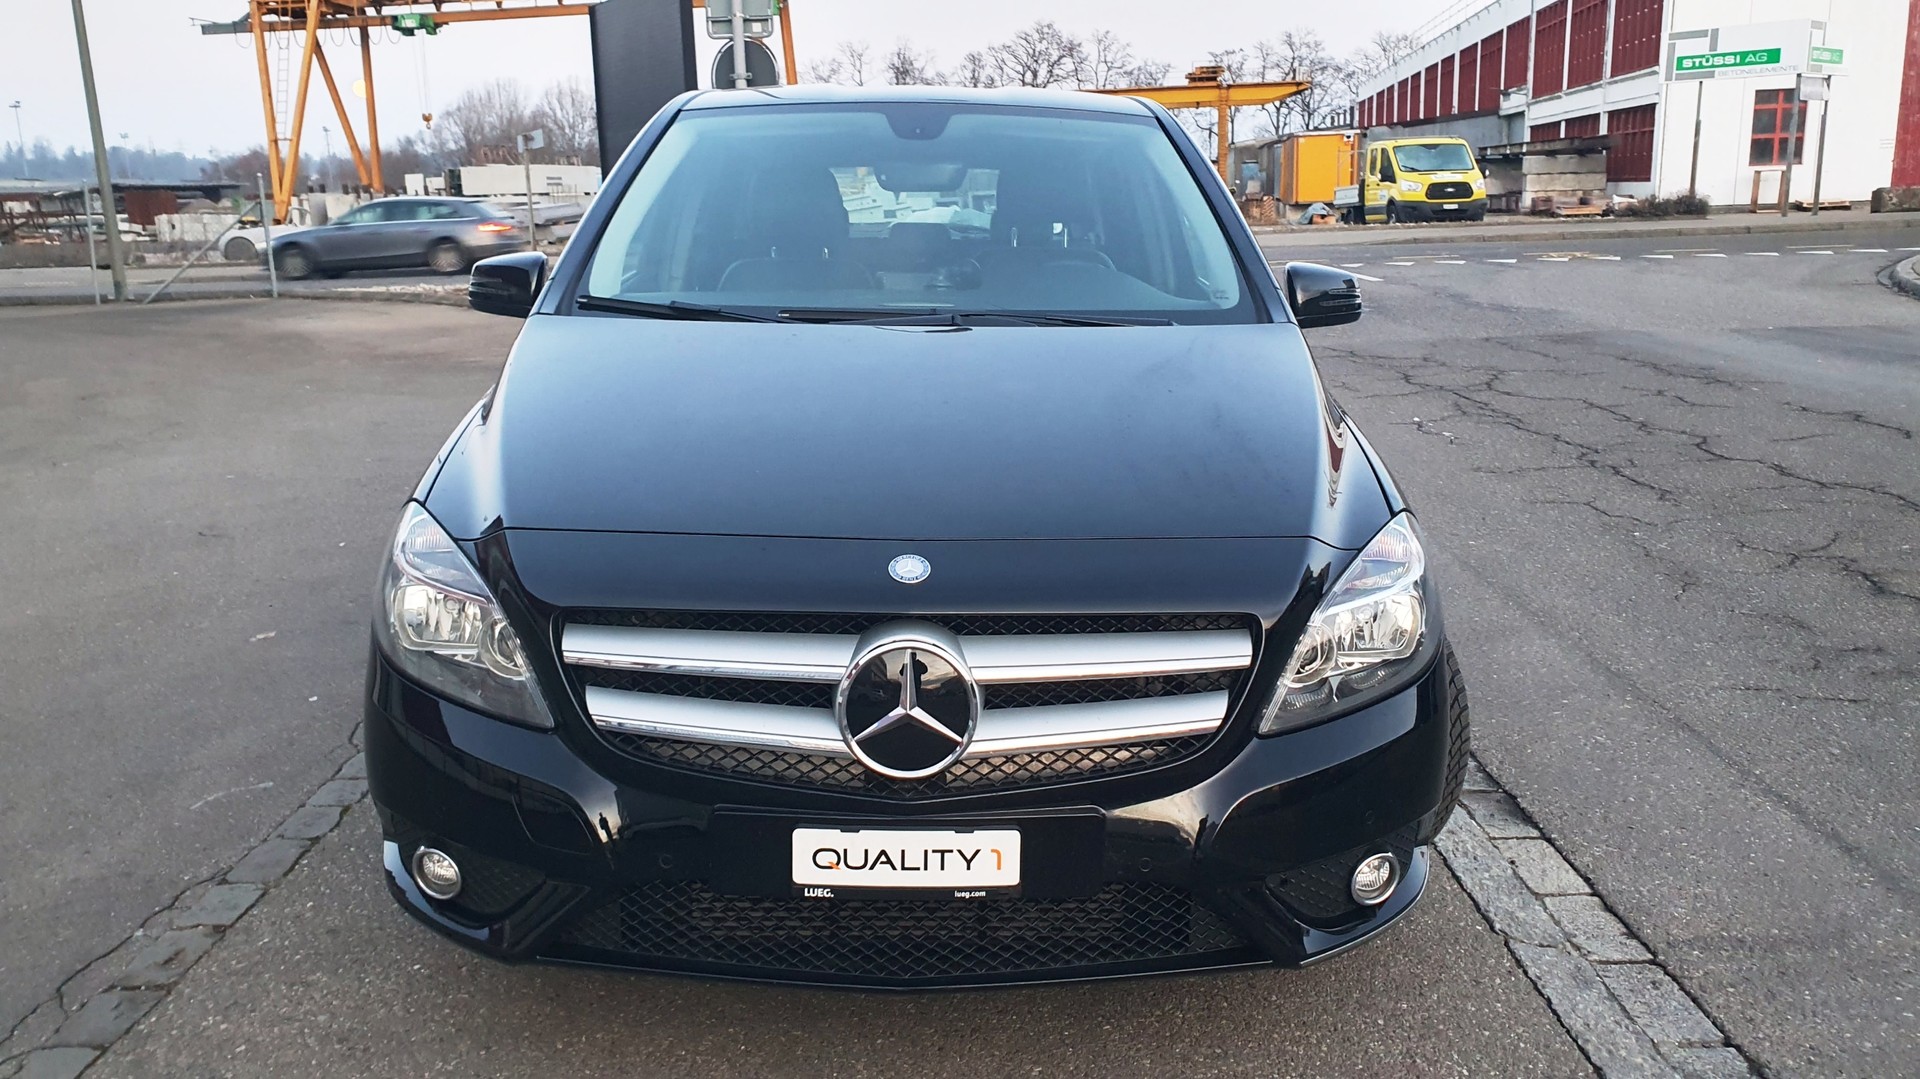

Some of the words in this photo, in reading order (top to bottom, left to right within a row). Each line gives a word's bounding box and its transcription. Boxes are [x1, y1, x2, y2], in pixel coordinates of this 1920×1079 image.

[1682, 55, 1740, 68] STÜSSI
[1745, 52, 1768, 63] AG
[812, 848, 981, 871] QUALITY
[990, 848, 1002, 871] 1
[804, 888, 834, 898] LUEG.
[954, 890, 986, 899] lueg.com
